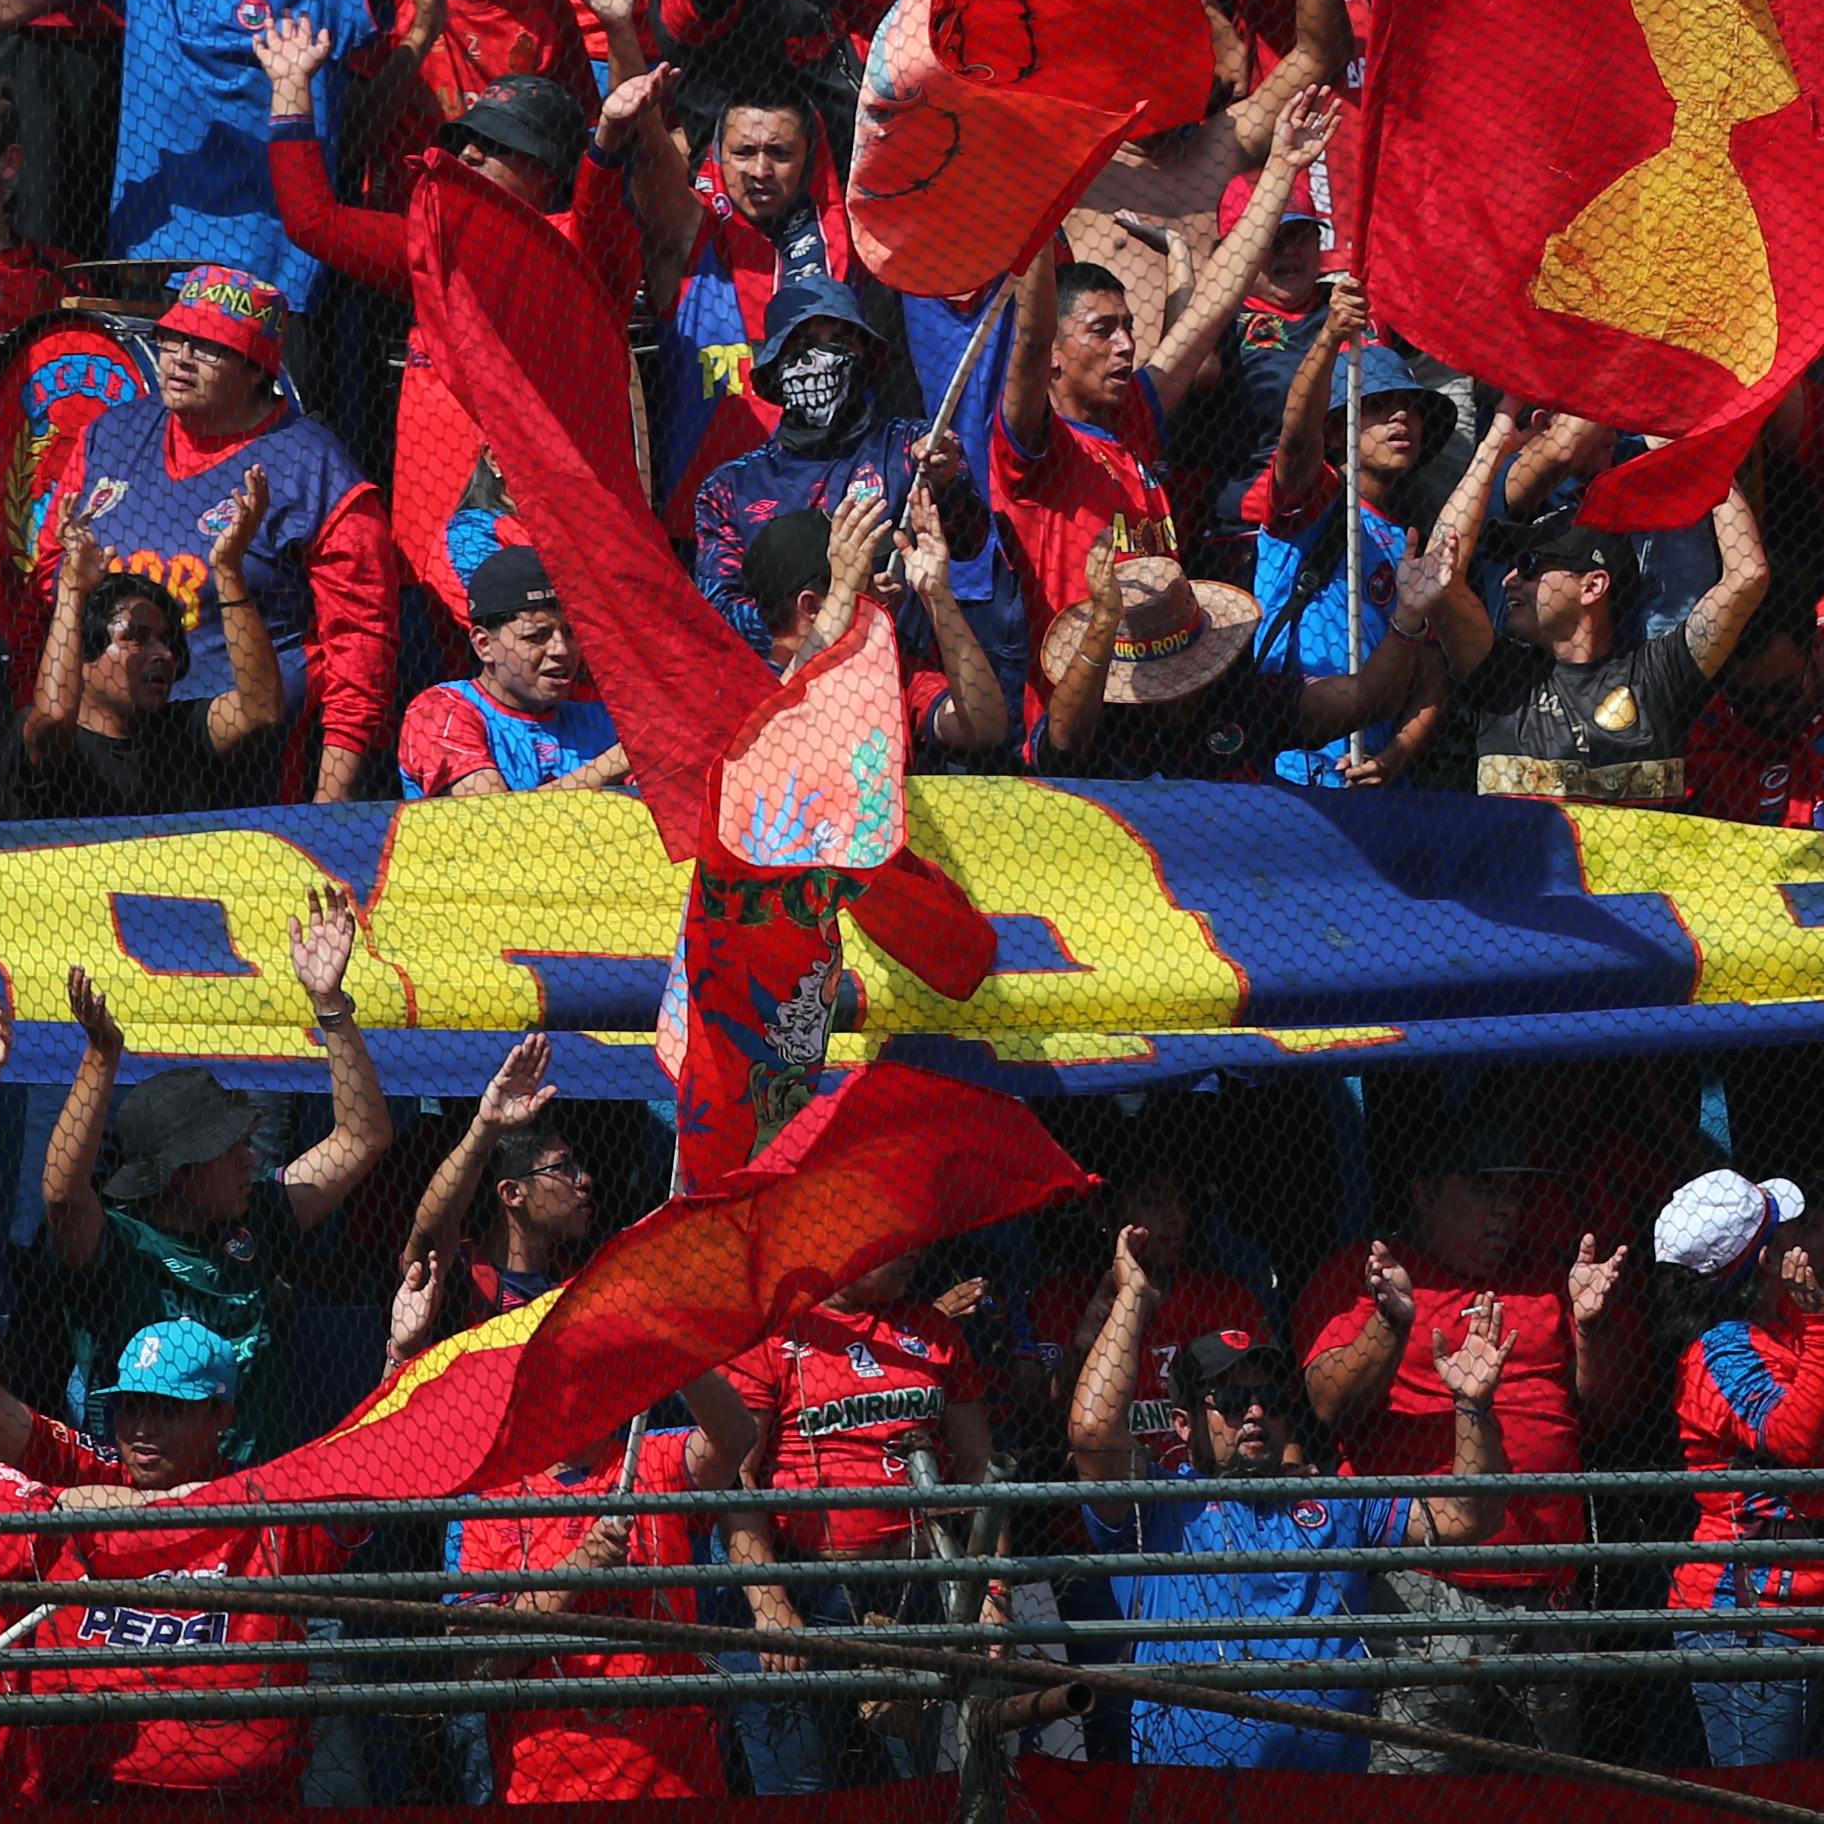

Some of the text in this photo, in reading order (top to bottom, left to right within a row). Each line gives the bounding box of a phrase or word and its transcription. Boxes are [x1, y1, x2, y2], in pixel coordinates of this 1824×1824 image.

[1112, 639, 1148, 661] URO
[800, 1389, 946, 1439] BANRURAL
[80, 1610, 226, 1647] PEPSI
